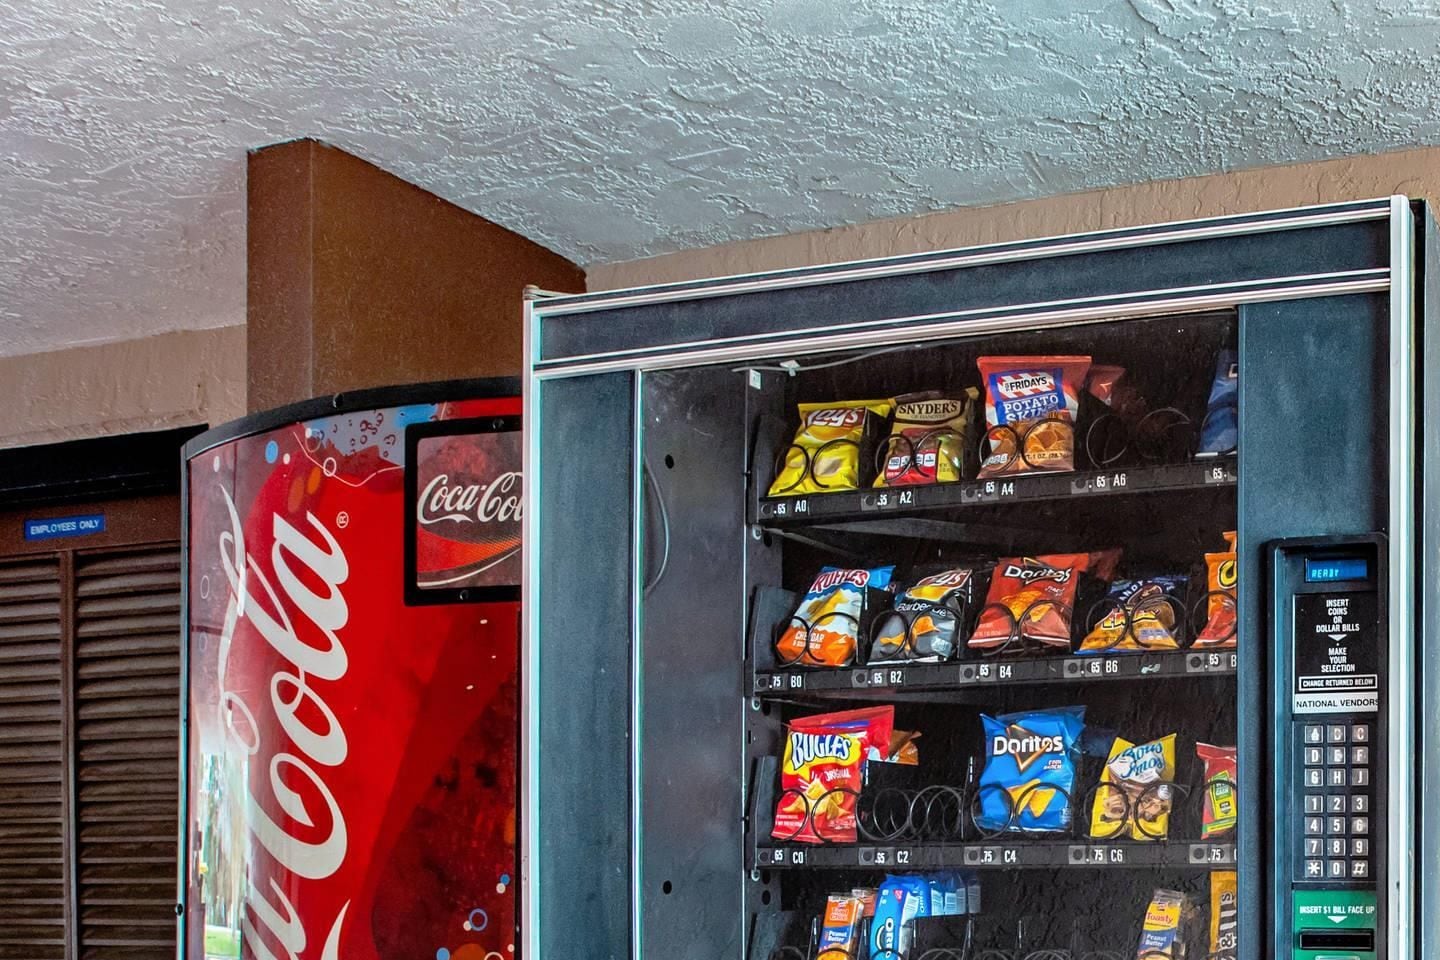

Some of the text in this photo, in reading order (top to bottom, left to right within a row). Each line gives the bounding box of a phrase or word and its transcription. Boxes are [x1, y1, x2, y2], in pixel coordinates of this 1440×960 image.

[1009, 377, 1048, 391] FRIDAYS
[898, 401, 958, 414] SNYDER'S
[1003, 395, 1060, 414] POTATO
[1113, 474, 1127, 487] A6
[1001, 482, 1014, 496] A4
[416, 471, 523, 525] Coca-Col
[900, 491, 912, 504] A2
[30, 519, 99, 535] EMPLOYEES ONLY
[1004, 564, 1073, 583] Doritos
[1311, 568, 1339, 578] READY
[895, 601, 948, 618] Barbeue
[1326, 599, 1349, 608] INSERT
[1328, 607, 1348, 616] COINS
[1333, 616, 1343, 625] OR
[1315, 623, 1360, 633] DOLLAR BILLS
[794, 630, 825, 643] CHEDAR
[1328, 647, 1347, 656] MAKE
[1329, 655, 1347, 664] YOUR
[1000, 665, 1012, 679] B4
[1105, 660, 1118, 673] B6
[1321, 664, 1356, 673] SELECTION
[1302, 678, 1374, 688] CHANGE RETURNED BELOW
[1296, 700, 1338, 709] NATIONAL
[1356, 727, 1364, 740] C
[790, 731, 851, 770] BUGLES
[993, 735, 1064, 756] Doritos
[1311, 749, 1319, 762] D
[1356, 749, 1363, 762] F
[1334, 771, 1341, 784] H
[1357, 771, 1363, 784] J
[1311, 797, 1363, 811] 1 2 3
[1310, 819, 1363, 832] 4 5 6
[1311, 840, 1363, 854] 7 8 9
[897, 850, 909, 863] C2
[980, 850, 1017, 863] .75 C4
[1086, 849, 1123, 863] .75 C6
[1207, 848, 1221, 861] .75
[1333, 862, 1340, 875] 0
[1299, 905, 1375, 914] INSERT $1 BILL FACE UP
[1147, 911, 1174, 923] Toasty
[827, 935, 845, 943] Butter
[828, 930, 847, 938] Peanut
[885, 917, 894, 959] OREO
[1146, 933, 1167, 941] Peanut
